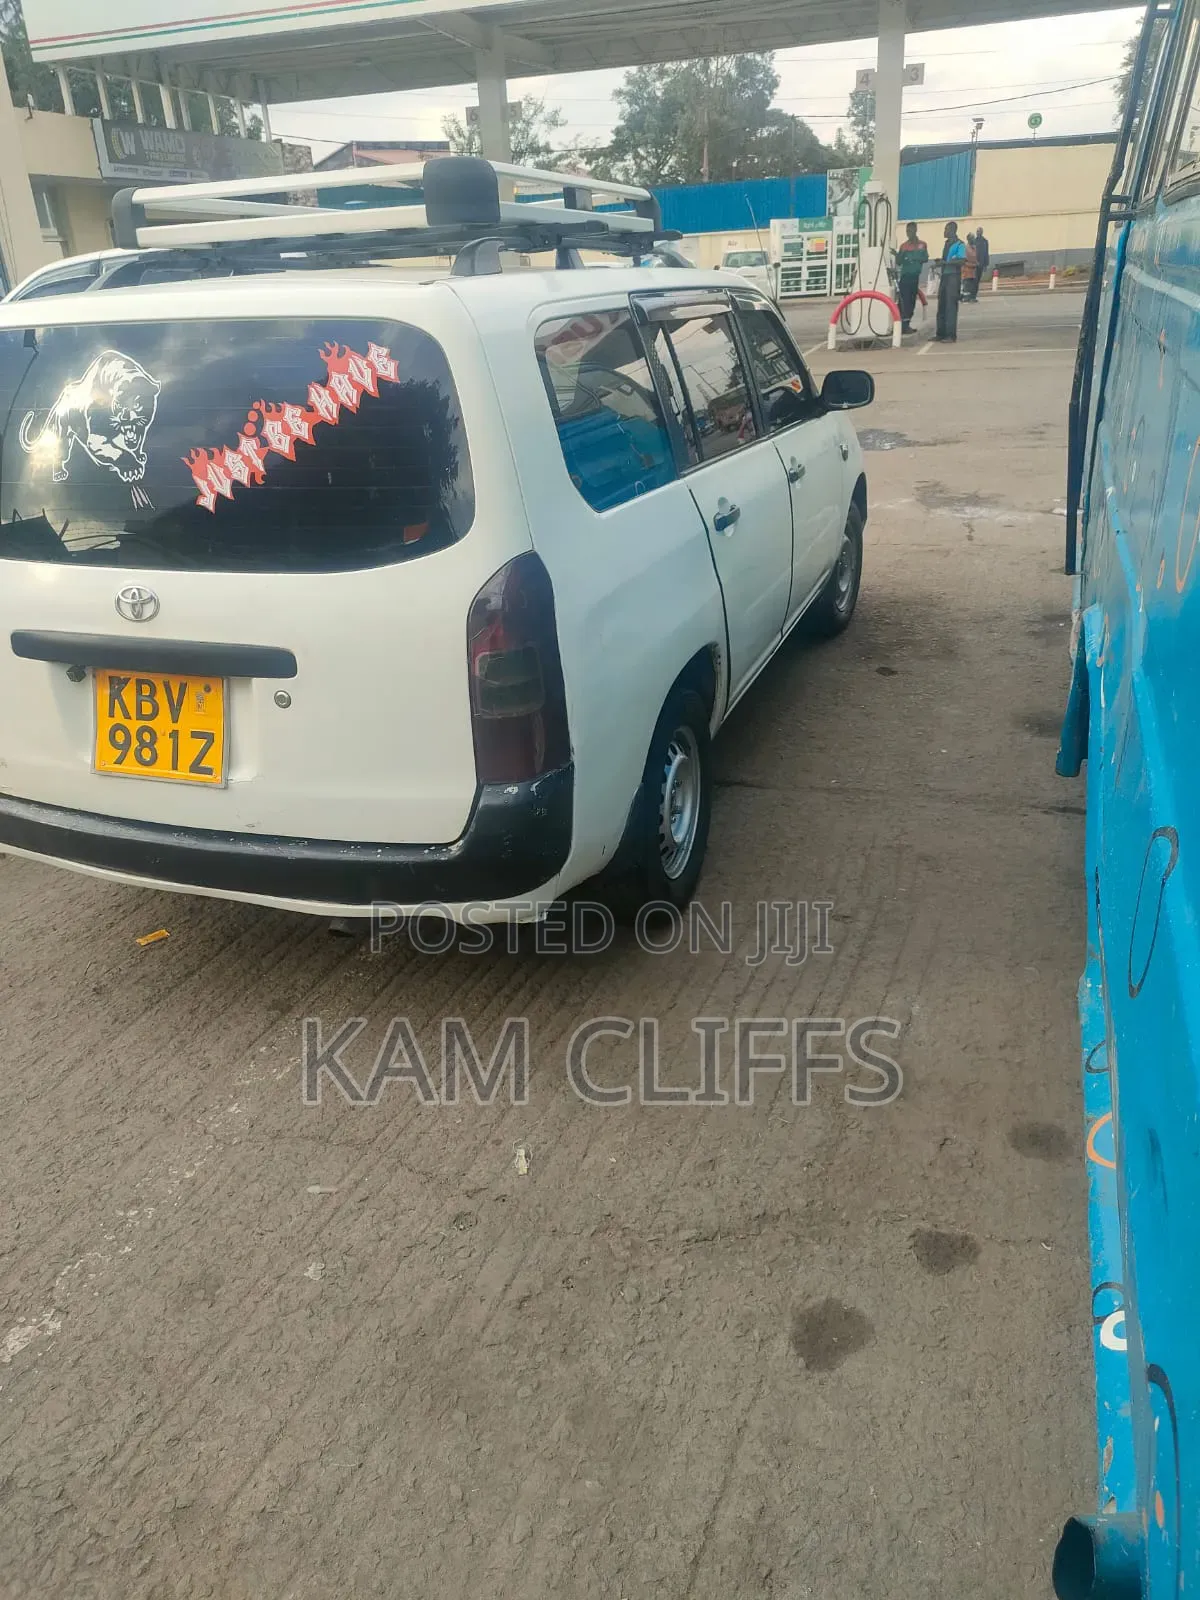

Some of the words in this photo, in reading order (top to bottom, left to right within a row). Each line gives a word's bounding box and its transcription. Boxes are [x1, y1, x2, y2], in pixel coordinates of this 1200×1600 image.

[910, 66, 920, 82] 3
[107, 675, 188, 724] KBV
[107, 722, 216, 776] 981Z
